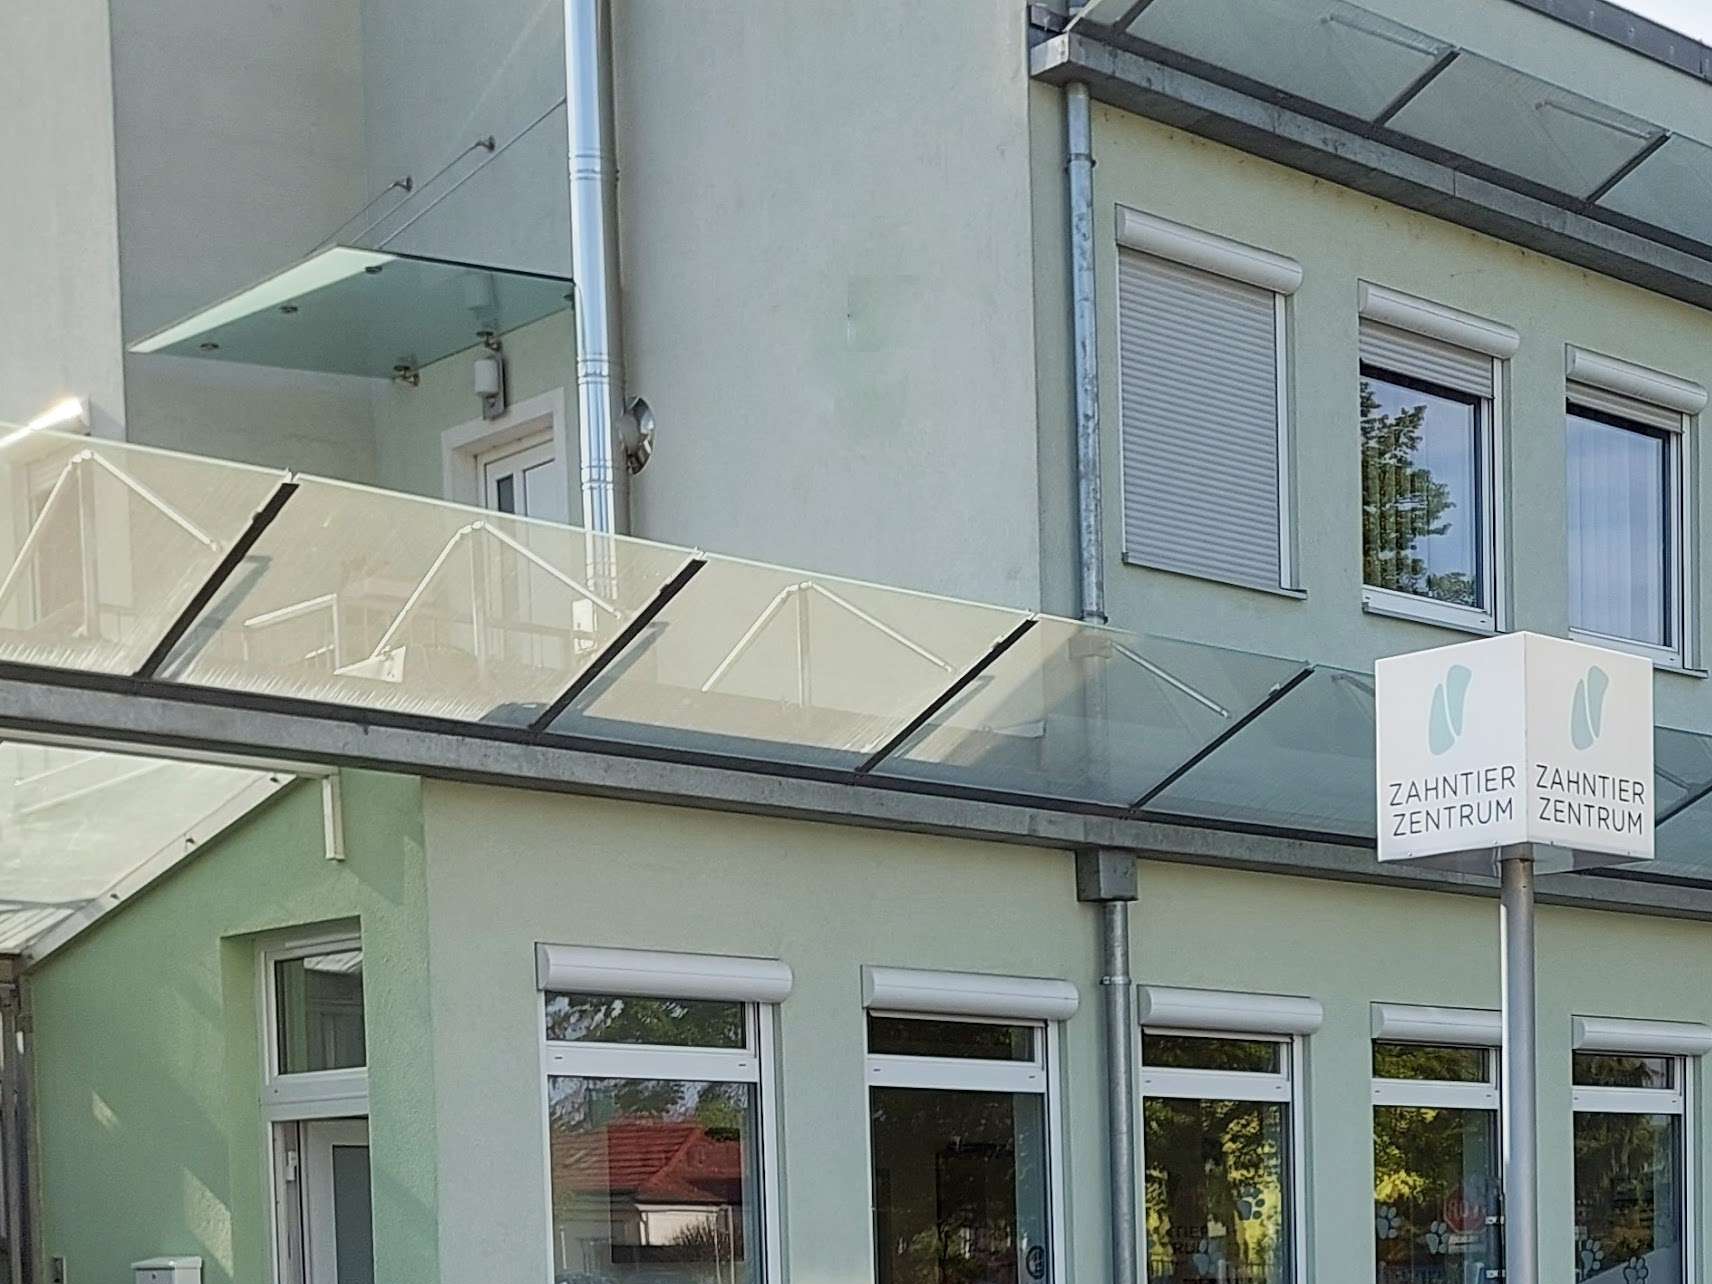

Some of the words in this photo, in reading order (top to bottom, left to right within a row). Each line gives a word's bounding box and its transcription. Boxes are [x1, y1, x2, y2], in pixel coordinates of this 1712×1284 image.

[1389, 766, 1516, 806] ZAHNTIER
[1536, 764, 1645, 804] ZAHNTIER
[1393, 798, 1513, 837] ZENTRUM
[1539, 797, 1642, 835] ZENTRUM
